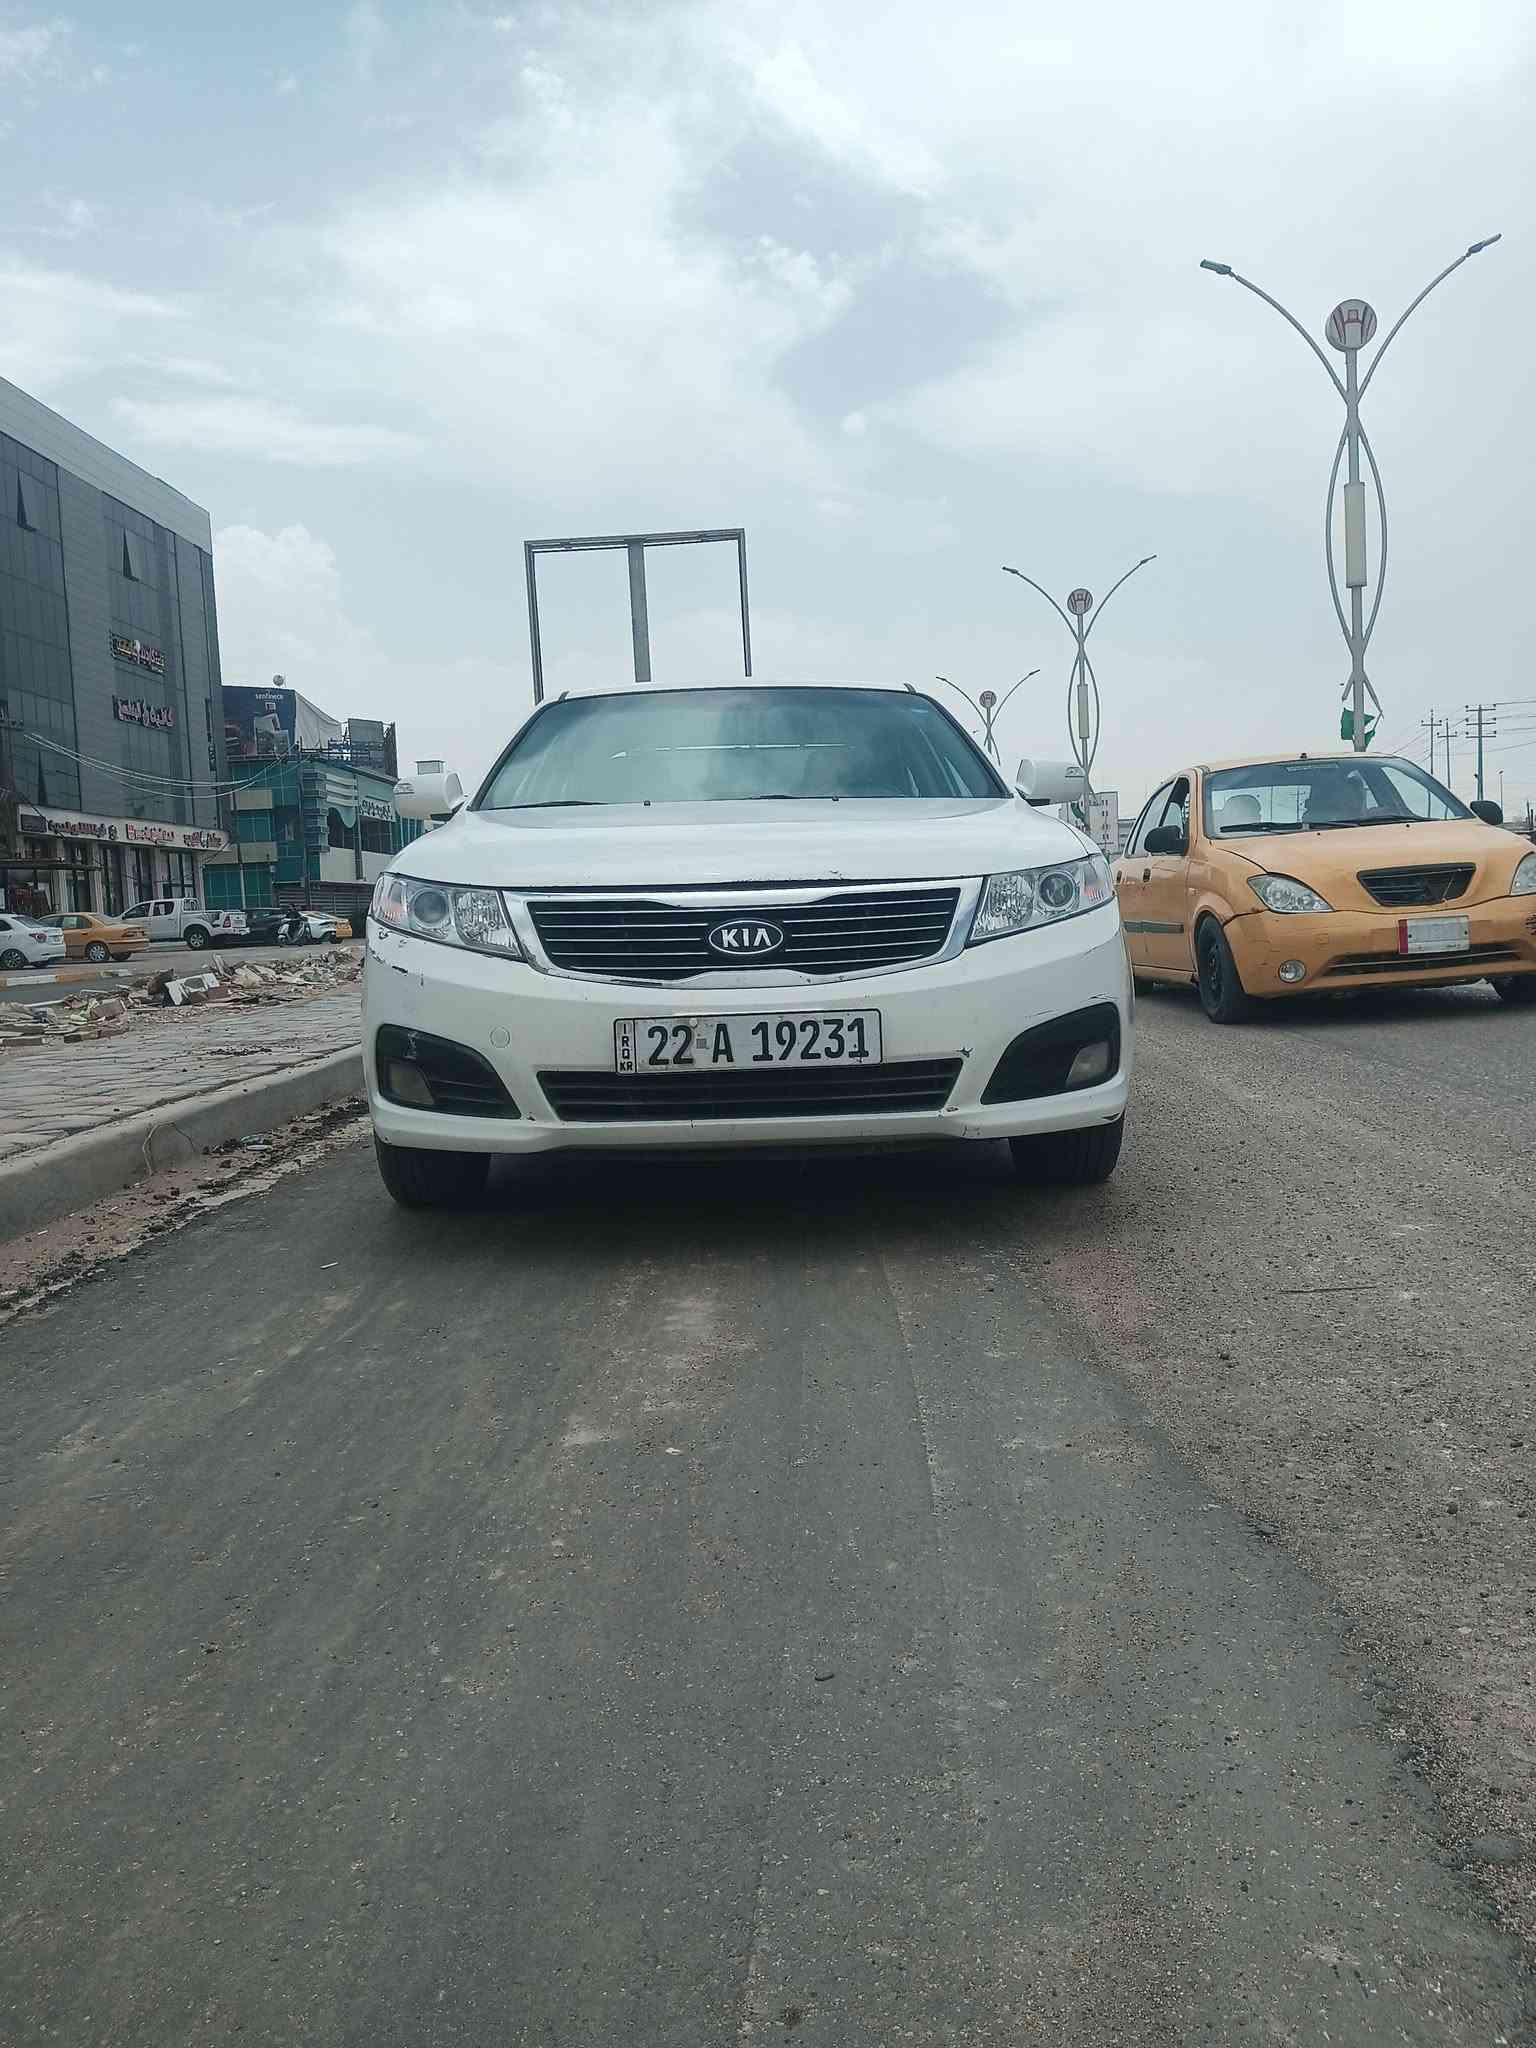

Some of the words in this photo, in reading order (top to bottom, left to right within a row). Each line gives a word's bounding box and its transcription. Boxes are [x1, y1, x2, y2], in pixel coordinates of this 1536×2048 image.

[721, 928, 771, 947] KIA
[648, 1025, 694, 1066] 22
[712, 1023, 734, 1063] A
[752, 1018, 870, 1062] 19231
[619, 1060, 633, 1072] KR
